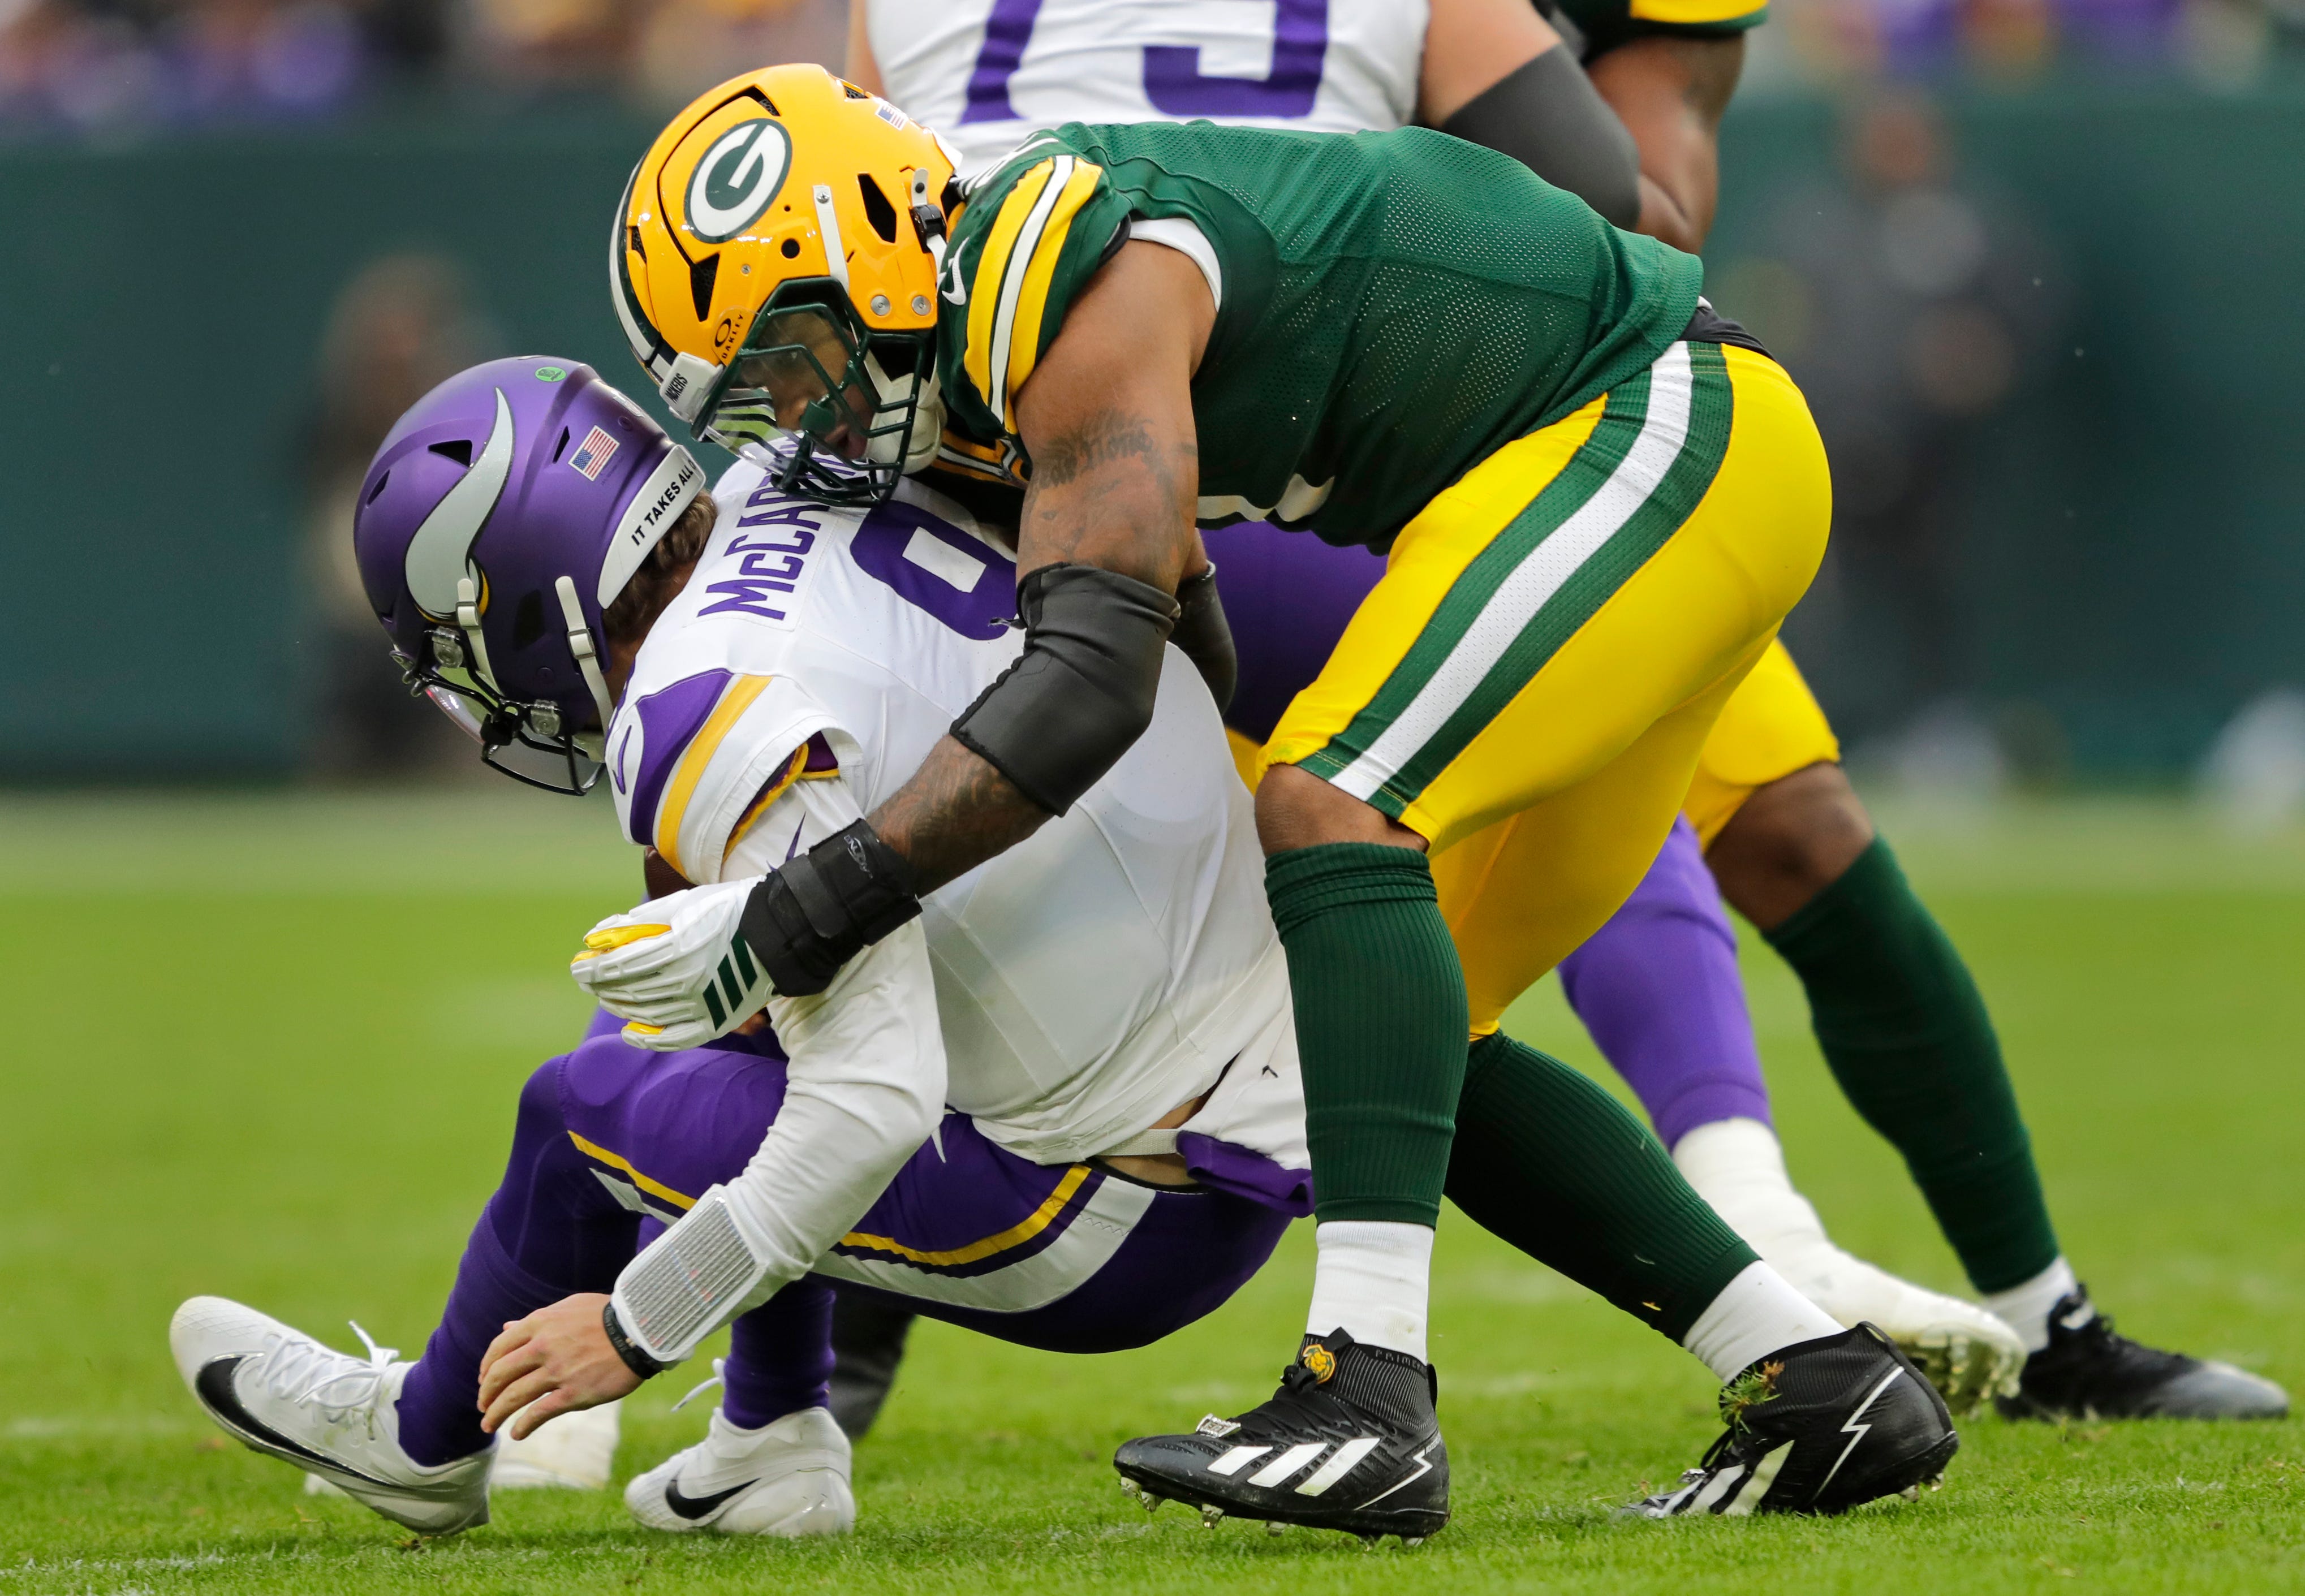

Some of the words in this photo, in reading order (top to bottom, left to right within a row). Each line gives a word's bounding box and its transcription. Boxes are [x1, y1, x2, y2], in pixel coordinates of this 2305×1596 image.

[689, 123, 787, 238] G
[721, 313, 744, 359] OAKLEY
[631, 524, 645, 546] IT
[644, 481, 681, 526] TAKES
[678, 465, 694, 486] ALL
